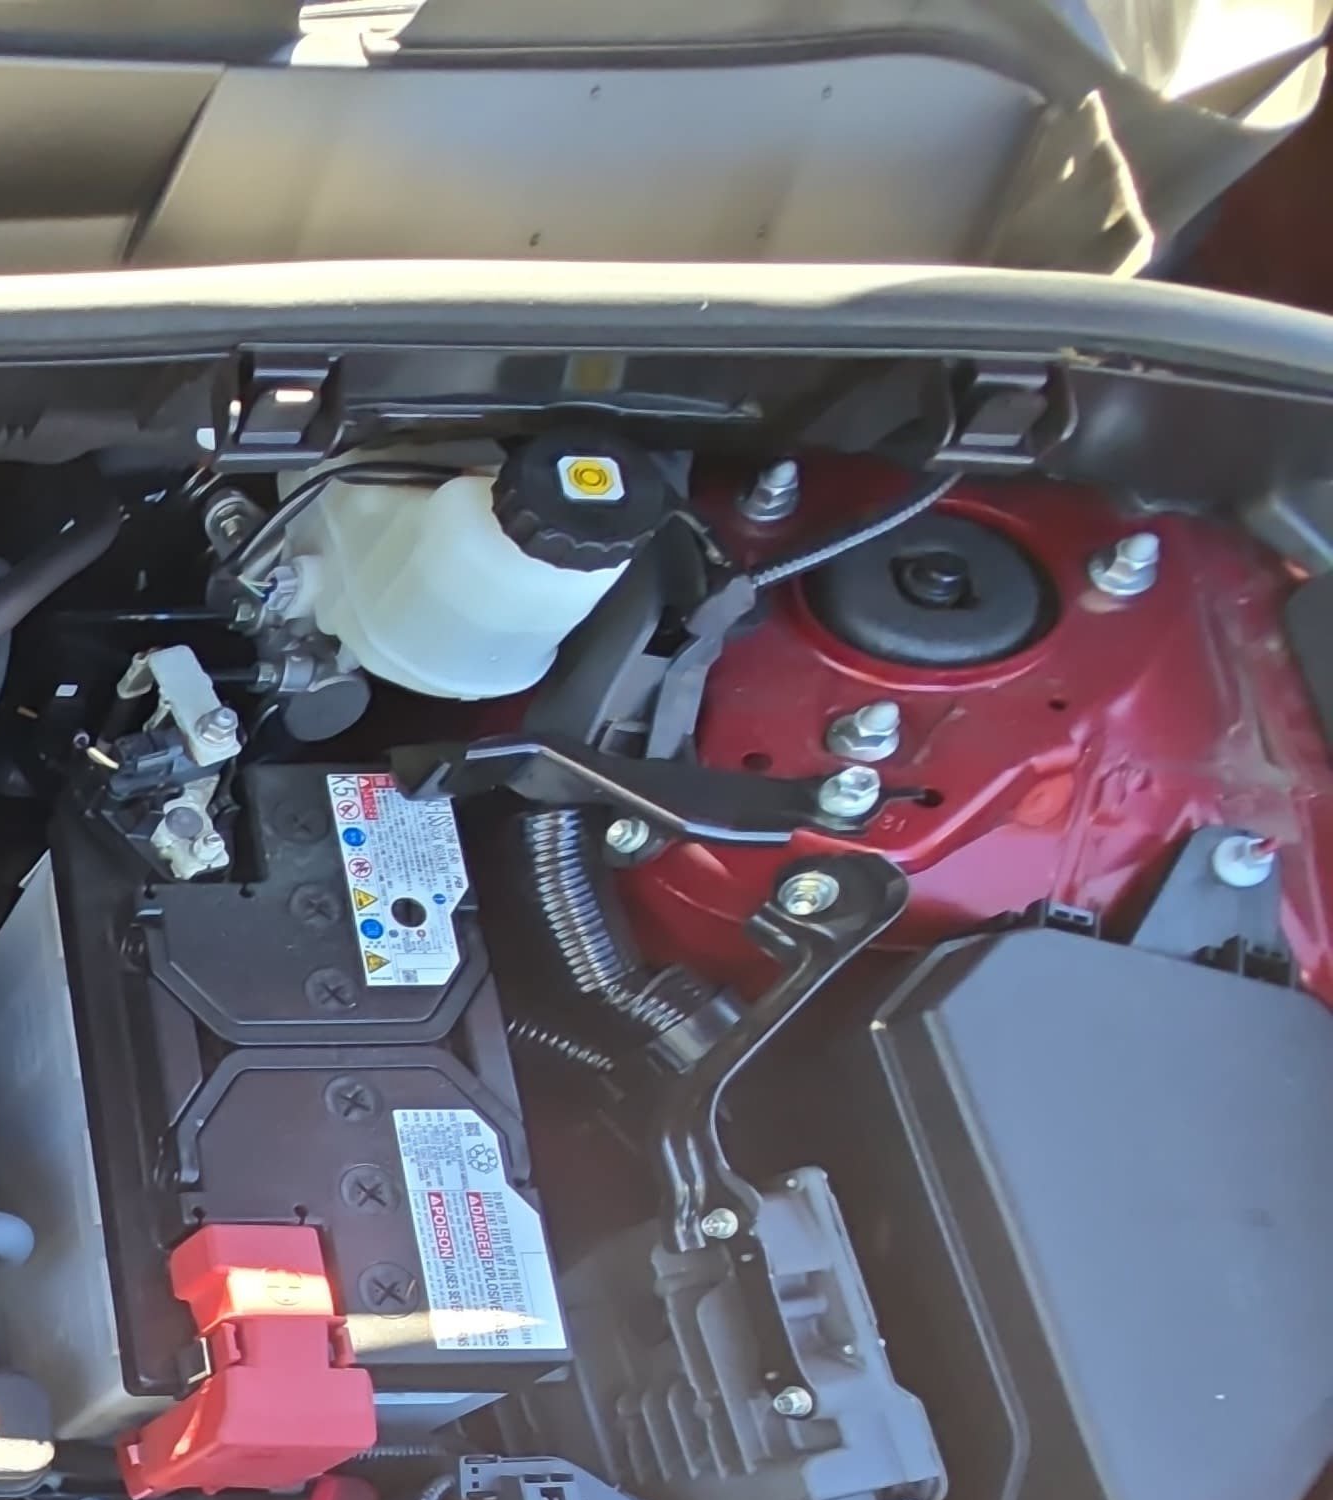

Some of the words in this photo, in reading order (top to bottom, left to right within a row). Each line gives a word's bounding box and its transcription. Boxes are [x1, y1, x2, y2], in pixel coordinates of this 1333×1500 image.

[331, 775, 358, 797] K5
[434, 1206, 453, 1257] POISON
[443, 1260, 459, 1288] CAUSES
[471, 1206, 492, 1257] DANGER
[482, 1260, 503, 1311] EXPLOSIVE
